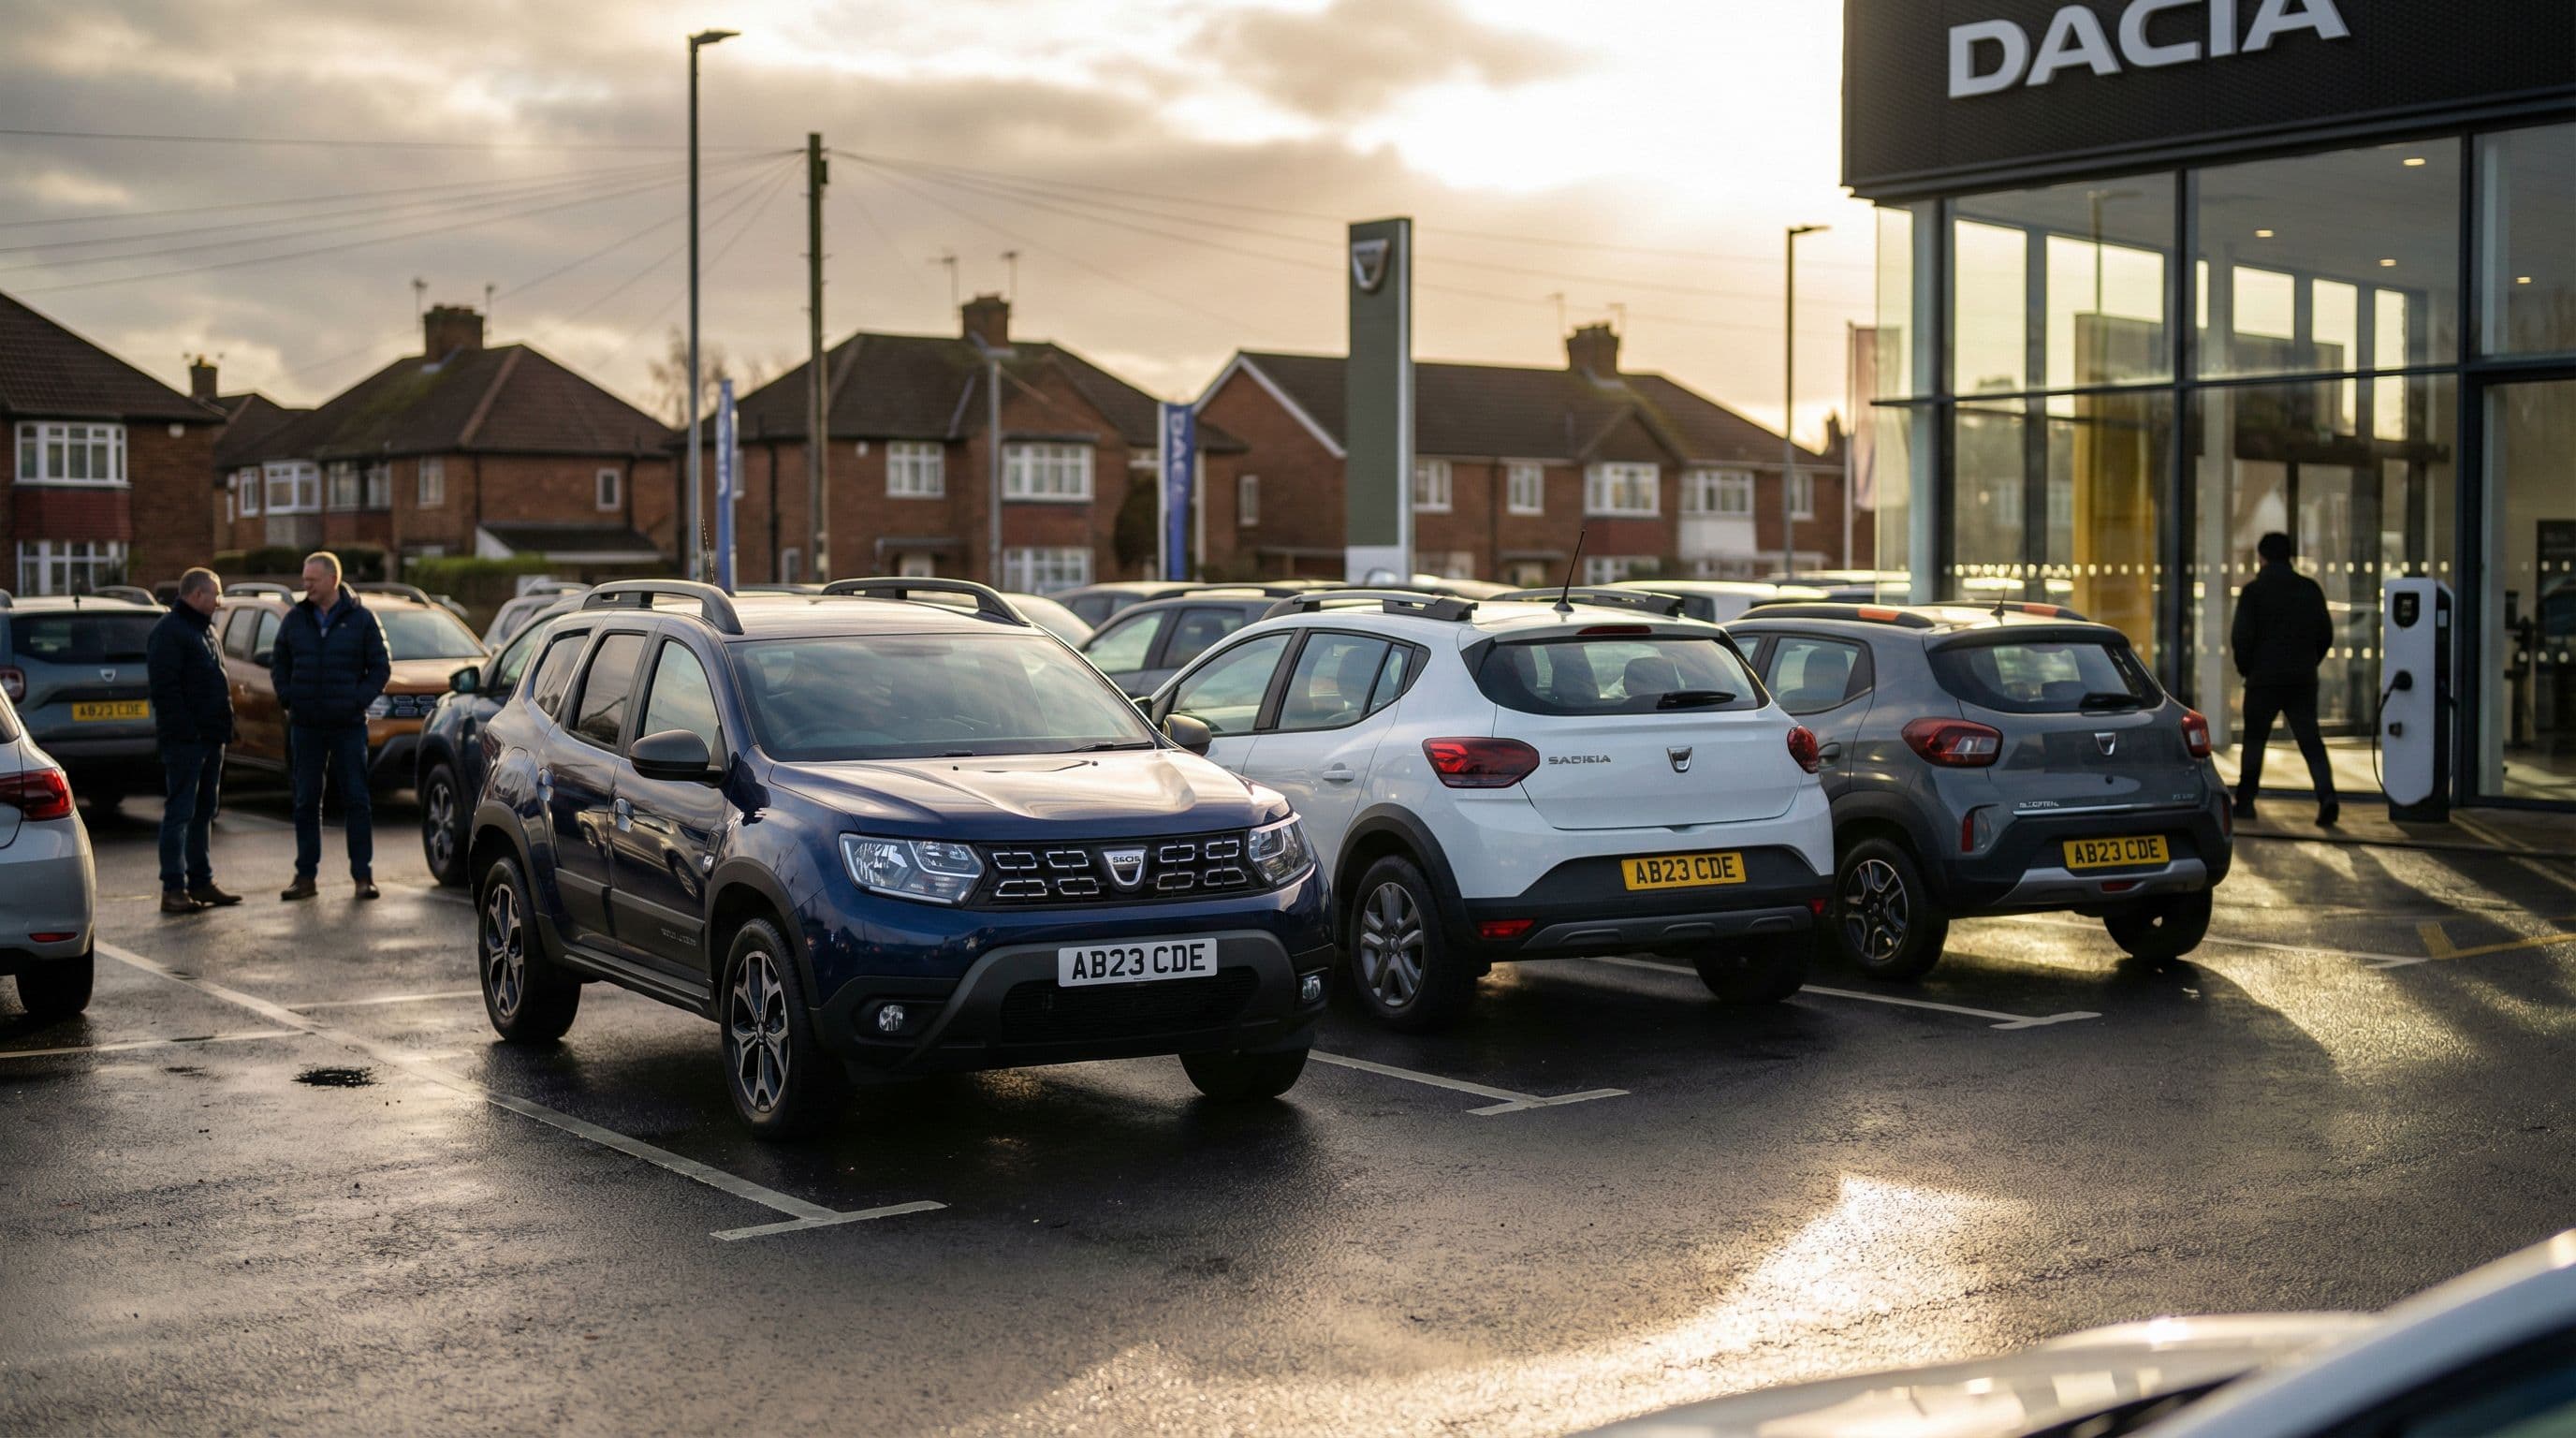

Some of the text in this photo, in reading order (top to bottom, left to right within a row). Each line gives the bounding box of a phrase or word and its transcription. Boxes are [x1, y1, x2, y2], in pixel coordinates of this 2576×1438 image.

[1948, 0, 2350, 98] DACIA
[2075, 839, 2160, 863] AB23 CDE
[1636, 857, 1736, 884] AB23 CDE
[1072, 943, 1206, 979] AB23 CDE
